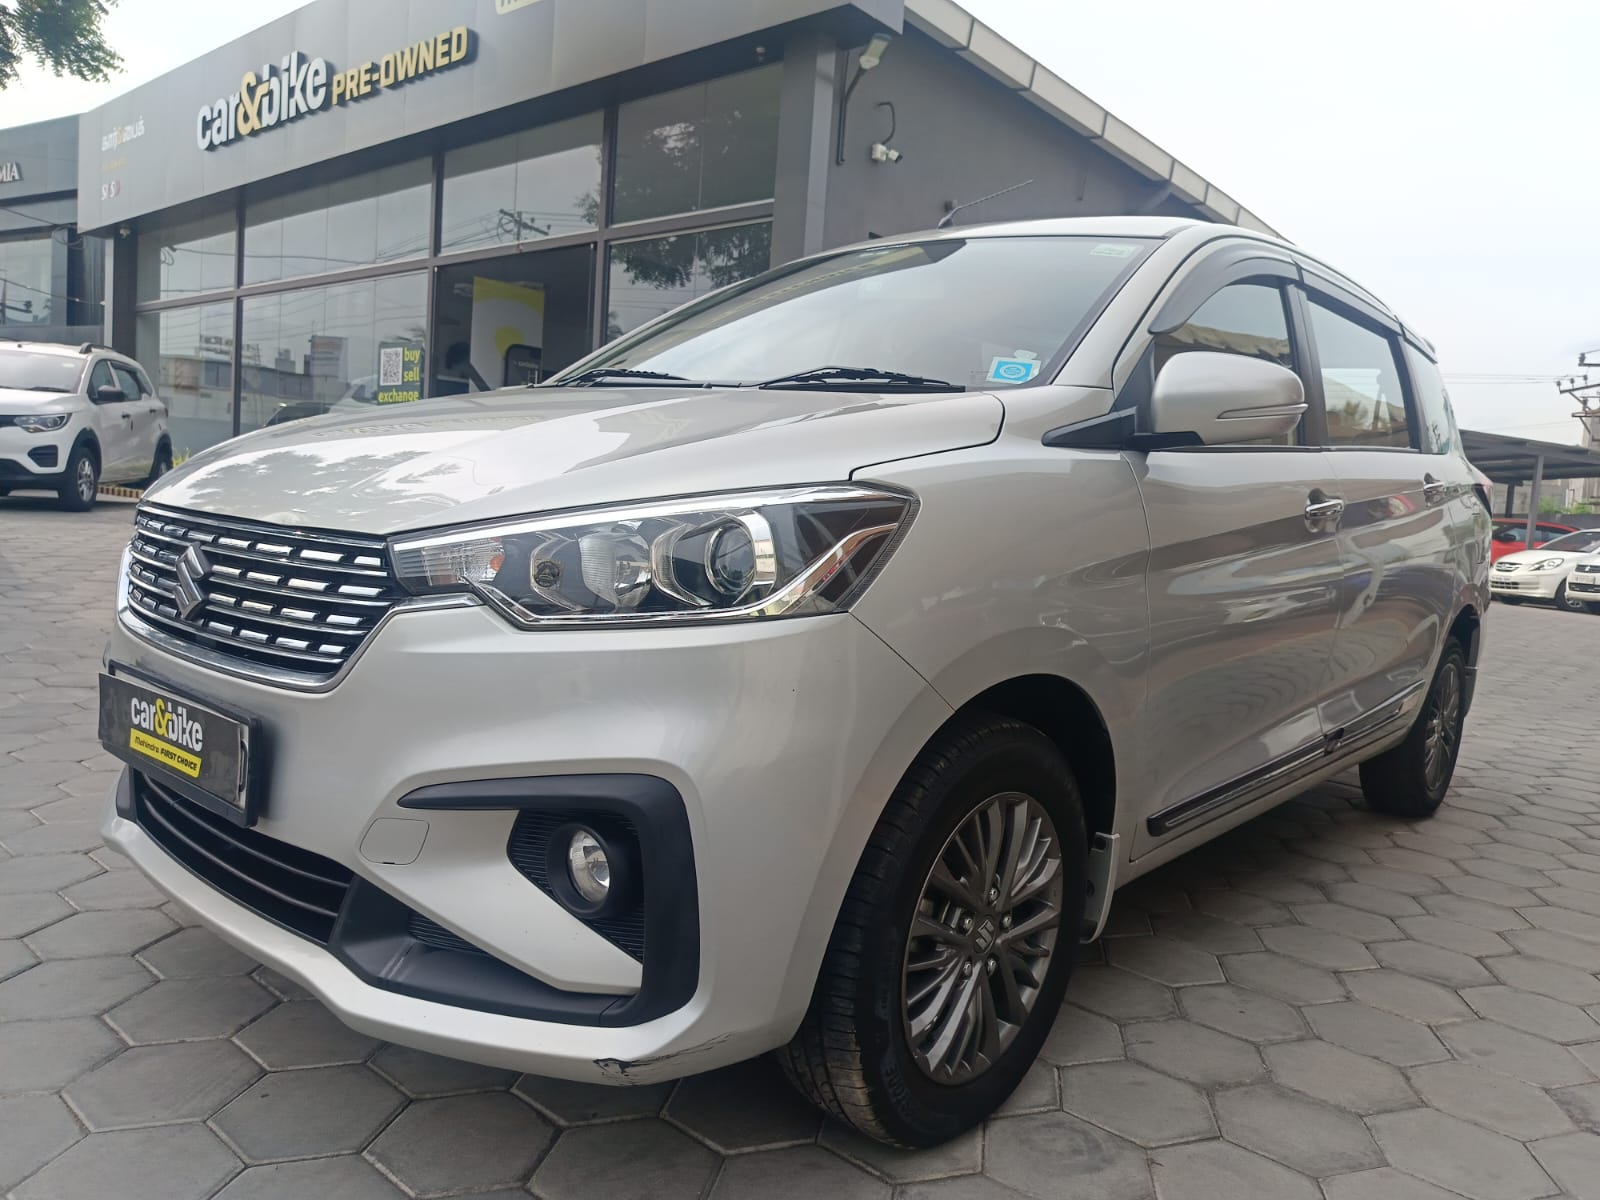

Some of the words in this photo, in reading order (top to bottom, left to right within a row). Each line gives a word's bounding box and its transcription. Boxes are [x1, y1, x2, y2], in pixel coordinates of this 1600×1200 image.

[196, 51, 328, 150] car&bike
[332, 26, 468, 105] PRE-OWNED
[404, 347, 420, 363] buy
[403, 367, 419, 382] sell
[378, 388, 419, 403] exchange
[130, 697, 203, 752] car&bike
[160, 747, 177, 761] FIRST
[177, 755, 198, 771] CHOICE
